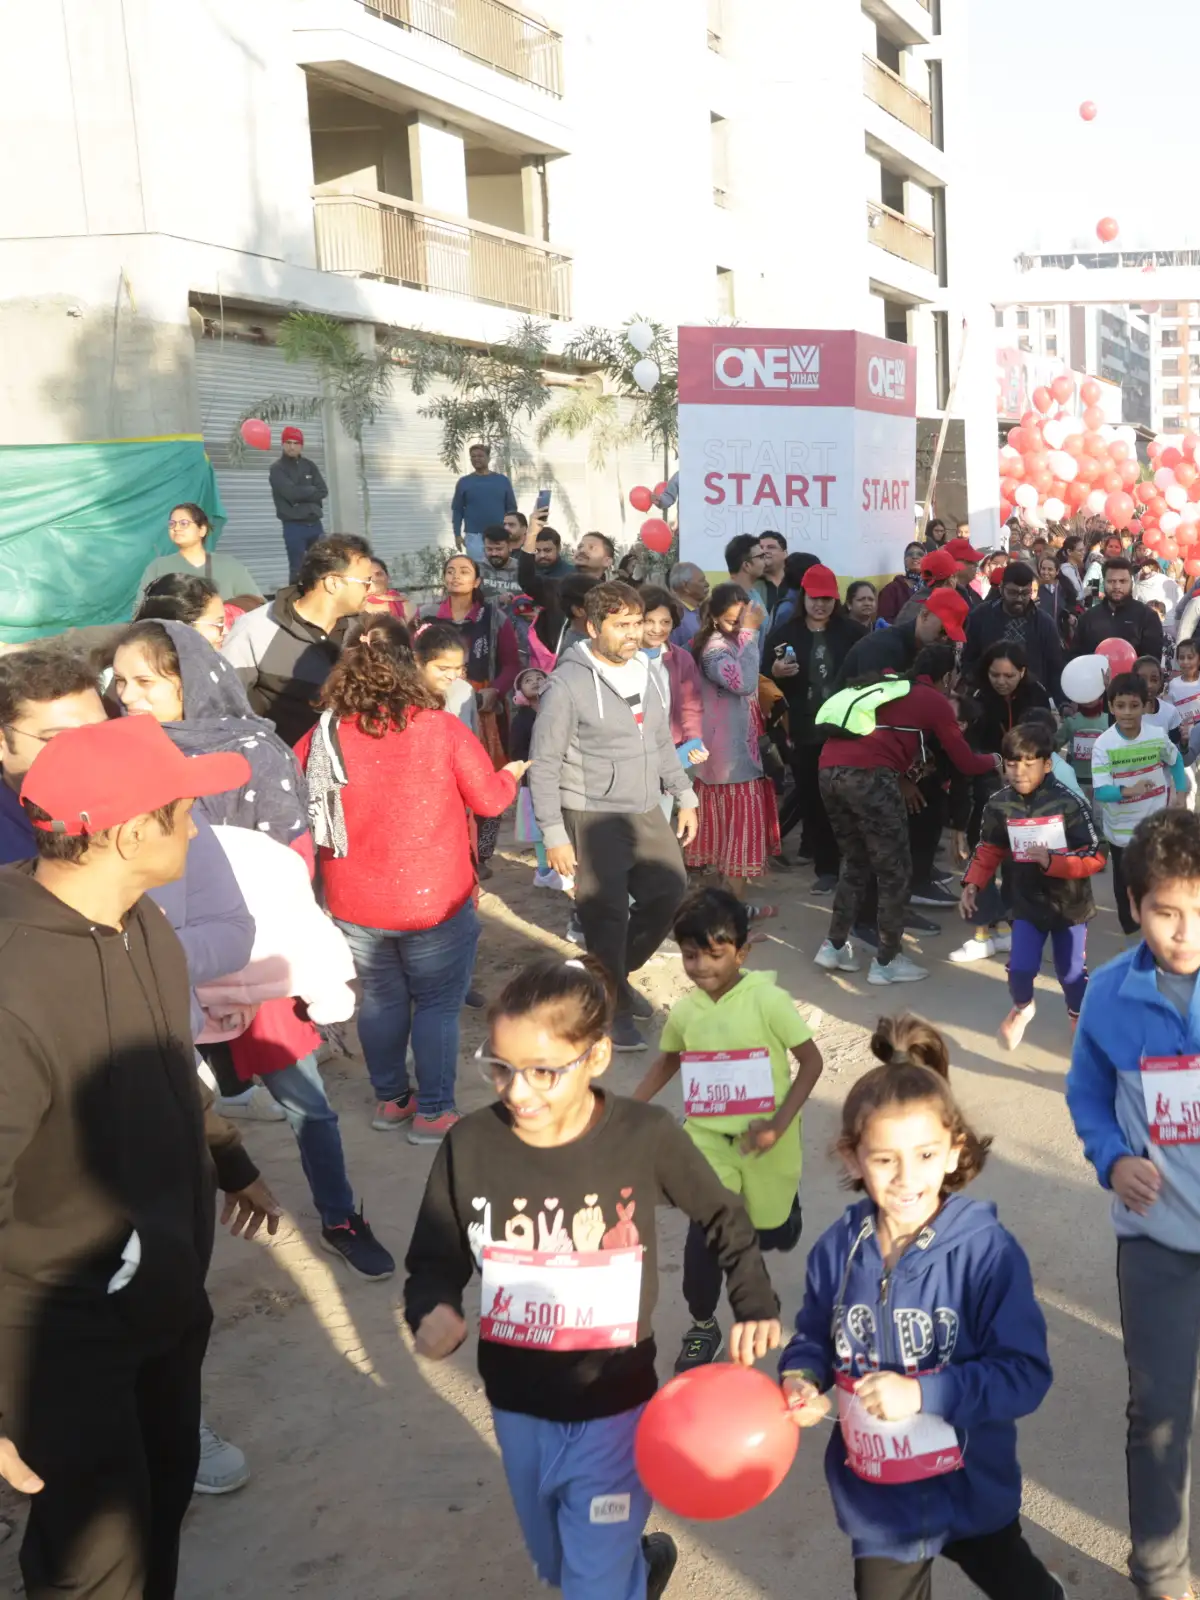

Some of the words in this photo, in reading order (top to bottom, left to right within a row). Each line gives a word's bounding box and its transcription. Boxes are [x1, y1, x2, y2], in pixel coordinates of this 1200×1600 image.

[715, 347, 788, 389] ONE
[868, 356, 895, 398] ONE
[703, 439, 837, 475] START
[704, 472, 837, 508] START
[862, 478, 910, 511] START
[707, 1084, 730, 1101] 500
[735, 1084, 747, 1101] M
[1160, 1126, 1177, 1140] RUN
[524, 1301, 566, 1328] 500
[575, 1306, 594, 1327] M
[491, 1322, 514, 1338] RUN
[525, 1327, 555, 1344] FUN!
[854, 1430, 886, 1459] 500
[892, 1434, 912, 1458] M
